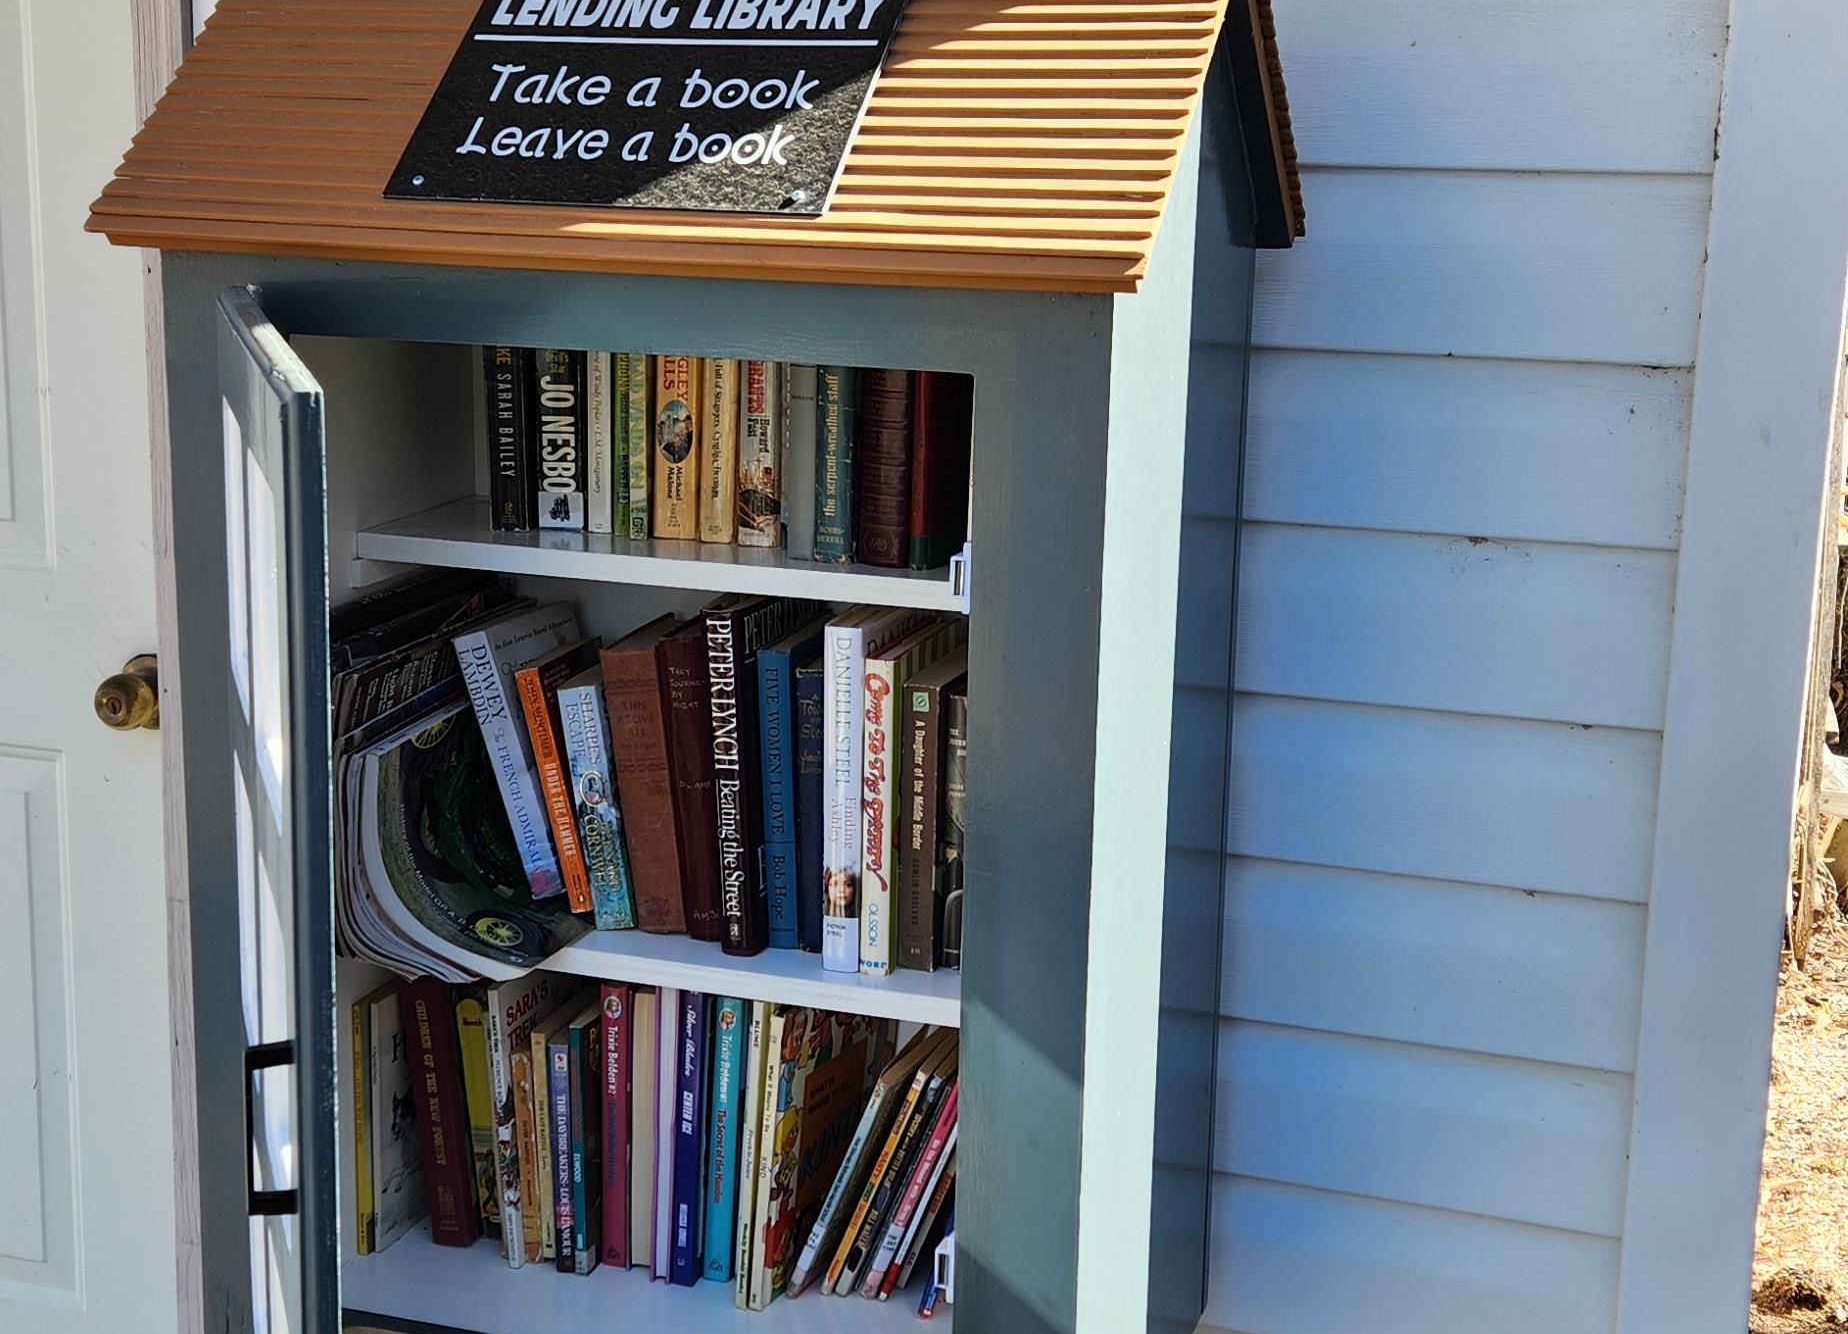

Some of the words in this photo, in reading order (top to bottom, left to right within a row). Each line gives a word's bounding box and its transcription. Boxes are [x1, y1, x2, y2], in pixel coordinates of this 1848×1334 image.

[488, 64, 612, 107] Take
[627, 75, 662, 109] a
[680, 69, 820, 110] book
[455, 117, 610, 161] Leave
[621, 128, 656, 163] a
[668, 123, 798, 166] book
[496, 373, 513, 419] SARAH
[540, 375, 575, 408] JO
[826, 372, 840, 401] staff
[747, 418, 758, 438] Fast
[759, 418, 770, 453] Howard
[498, 427, 517, 477] BAILEY
[824, 403, 839, 492] serpent-wreathed
[675, 465, 683, 501] Michael
[824, 495, 836, 517] the
[706, 618, 735, 693] PETER
[458, 648, 494, 727] LAMBDIN
[470, 642, 508, 721] DEWEY
[765, 668, 779, 705] FIVE
[835, 637, 853, 731] DANIELLE
[565, 702, 587, 759] ESCAPE
[578, 692, 603, 766] SHARPE'S
[711, 697, 740, 771] LYNCH
[767, 711, 782, 774] WOMEN
[835, 736, 852, 788] STEEL
[912, 729, 927, 766] Daughter
[543, 762, 563, 795] UNDER
[913, 767, 924, 778] of
[913, 780, 925, 793] the
[497, 746, 523, 806] FRENCH
[515, 802, 545, 874] ADMIRAL
[553, 796, 567, 815] THE
[718, 778, 741, 839] Beating
[769, 790, 785, 835] LOVE
[831, 797, 844, 847] Ashley
[845, 795, 857, 851] Finding
[912, 796, 925, 822] Middle
[558, 816, 578, 857] HAMMER
[911, 824, 925, 851] Border
[723, 843, 745, 869] the
[773, 855, 786, 880] Bob
[724, 870, 745, 917] Street
[772, 885, 787, 921] Hope
[868, 903, 879, 947] OLSSON
[506, 978, 549, 1027] SARA'S
[415, 999, 432, 1050] CHILDREN
[607, 1026, 619, 1051] Trixie
[686, 1005, 697, 1037] Silver
[423, 1054, 433, 1068] OF
[685, 1039, 697, 1077] Blades
[720, 1035, 732, 1059] Trixie
[426, 1071, 438, 1094] THE
[607, 1052, 618, 1083] Belden
[719, 1060, 731, 1095] Belden
[428, 1096, 440, 1122] NEW
[556, 1095, 566, 1115] THE
[682, 1090, 694, 1119] CENTER
[718, 1109, 727, 1124] The
[432, 1125, 447, 1166] FOREST
[681, 1120, 692, 1136] ICE
[717, 1124, 726, 1148] Secret
[557, 1116, 569, 1184] DAYBREAKERS
[715, 1160, 724, 1172] the
[716, 1148, 725, 1159] of
[560, 1187, 570, 1215] LOUIS
[714, 1173, 724, 1204] Mansion
[561, 1215, 572, 1256] L'AMOUR
